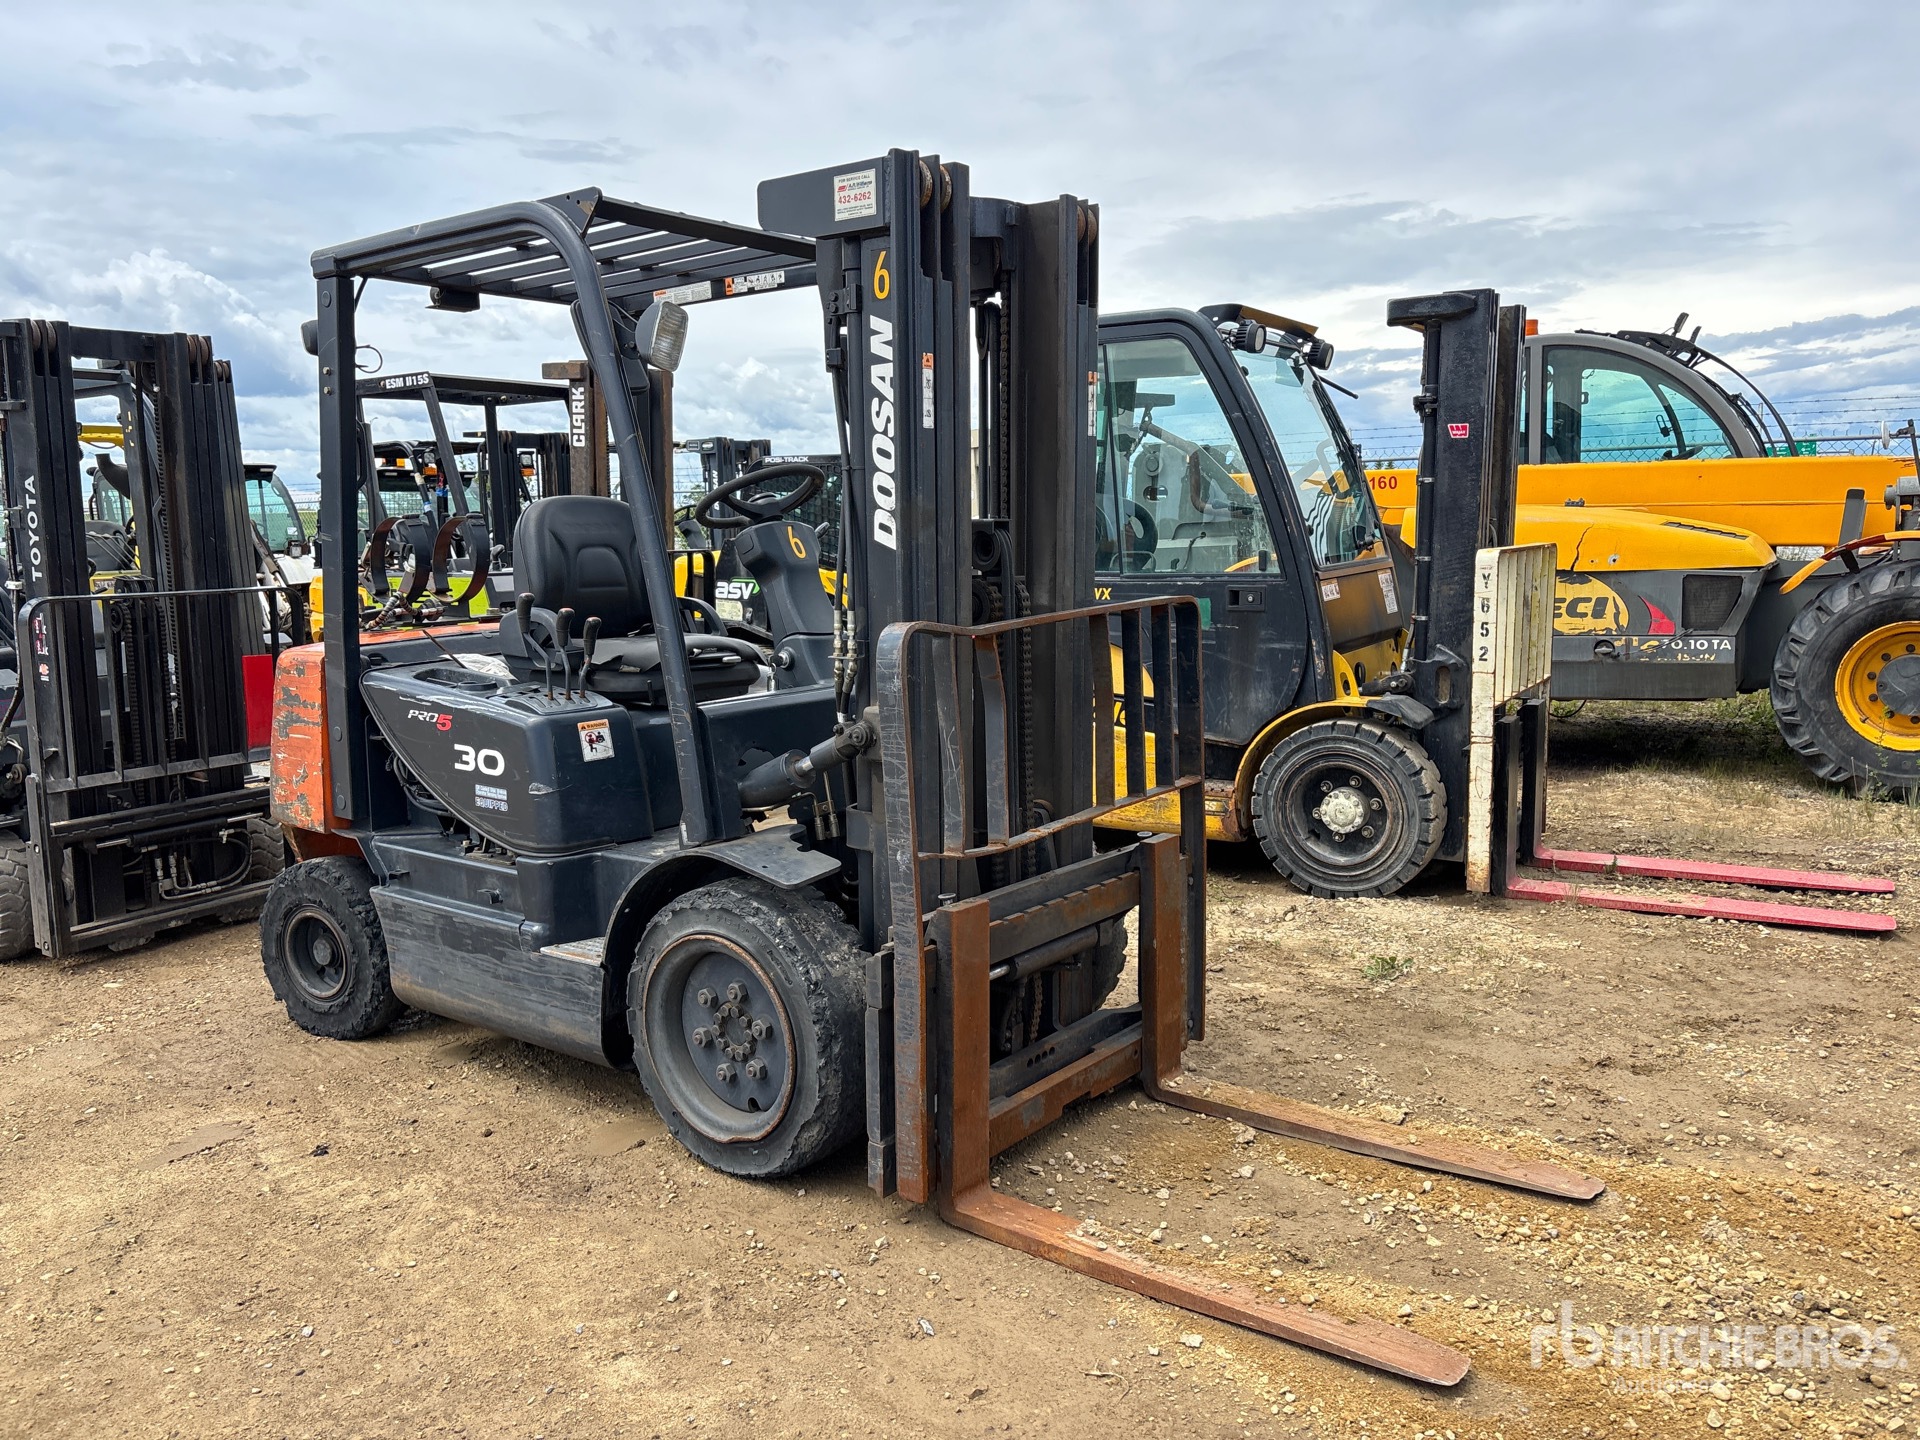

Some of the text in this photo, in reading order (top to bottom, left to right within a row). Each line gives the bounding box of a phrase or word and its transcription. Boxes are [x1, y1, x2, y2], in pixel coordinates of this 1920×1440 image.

[838, 191, 872, 204] 432-6262
[873, 250, 891, 300] 6
[385, 377, 404, 390] ESM
[571, 386, 586, 448] CLARK
[869, 314, 897, 551] DOOSAN
[764, 456, 809, 464] POSI-TRACK
[1368, 475, 1398, 491] 160
[24, 475, 44, 582] TOYOTA
[787, 525, 807, 559] 6
[1711, 639, 1732, 650] TA
[453, 743, 506, 777] 30
